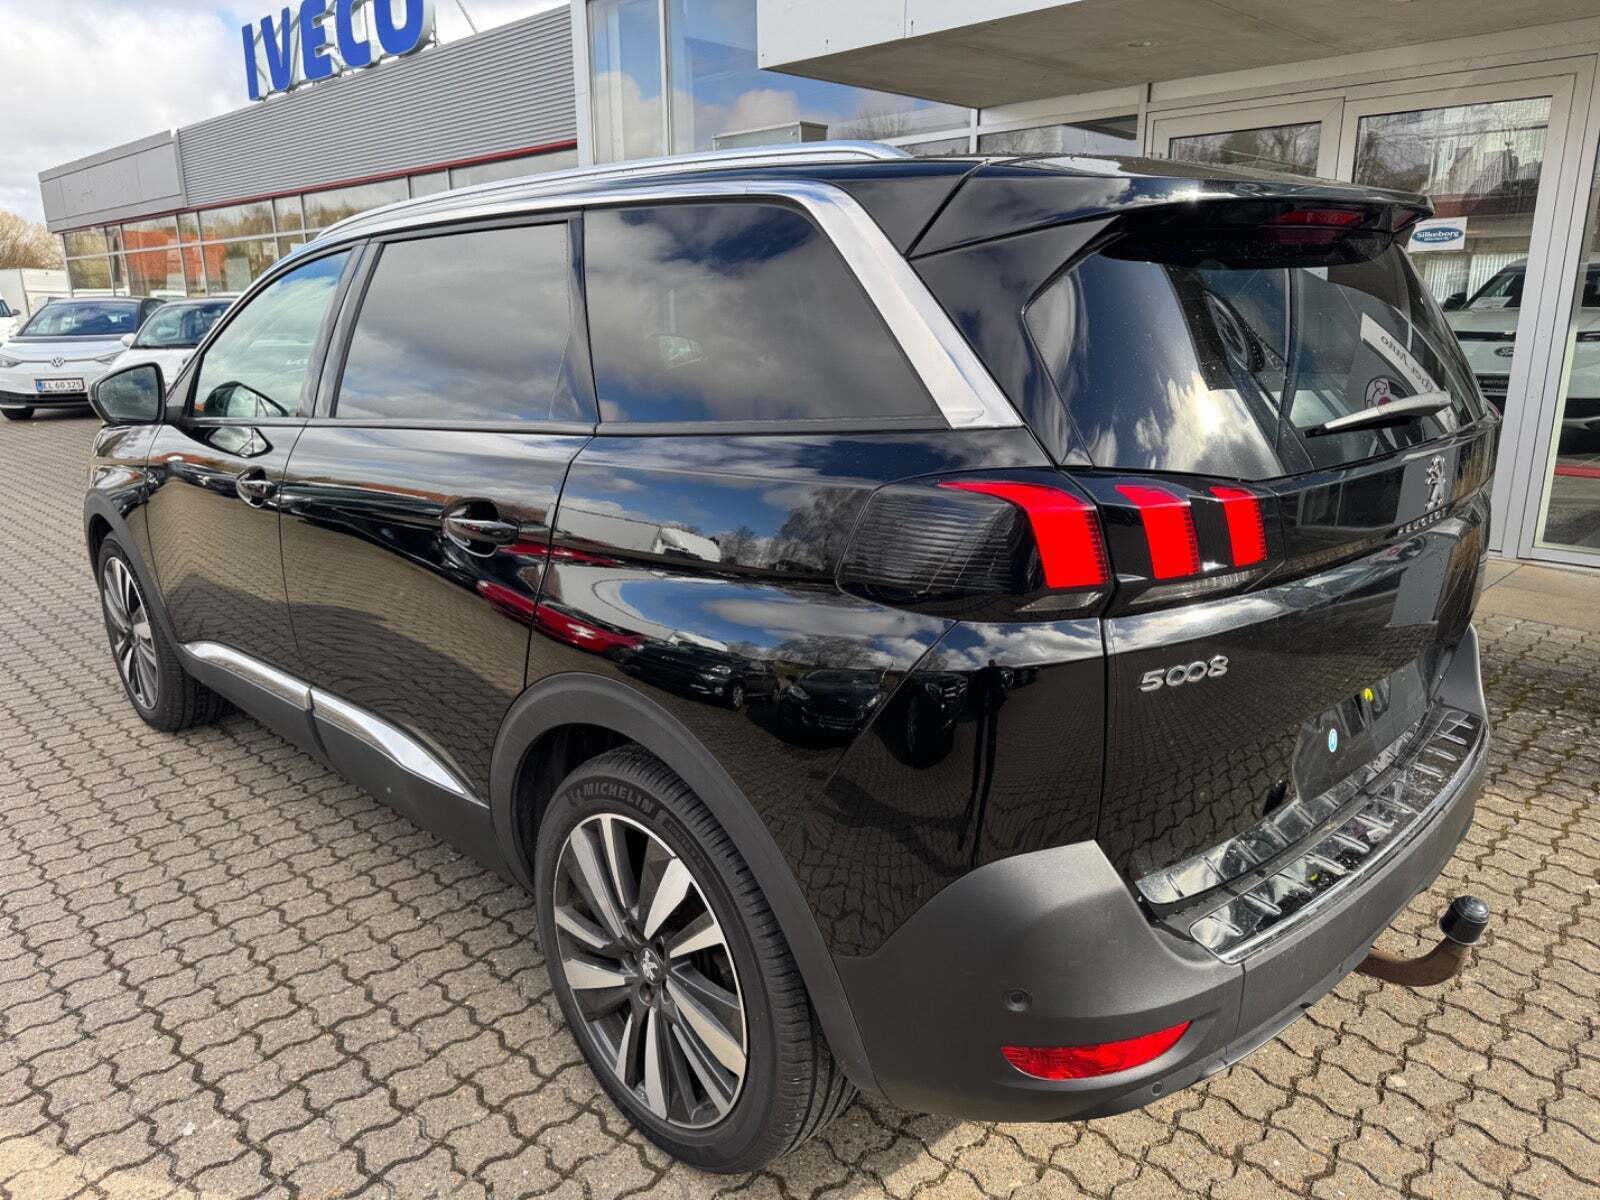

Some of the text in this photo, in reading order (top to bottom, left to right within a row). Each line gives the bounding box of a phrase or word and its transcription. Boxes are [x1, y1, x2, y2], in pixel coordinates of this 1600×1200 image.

[242, 0, 424, 101] IVECO
[1139, 655, 1229, 692] 5008
[584, 782, 654, 814] MICHELIN
